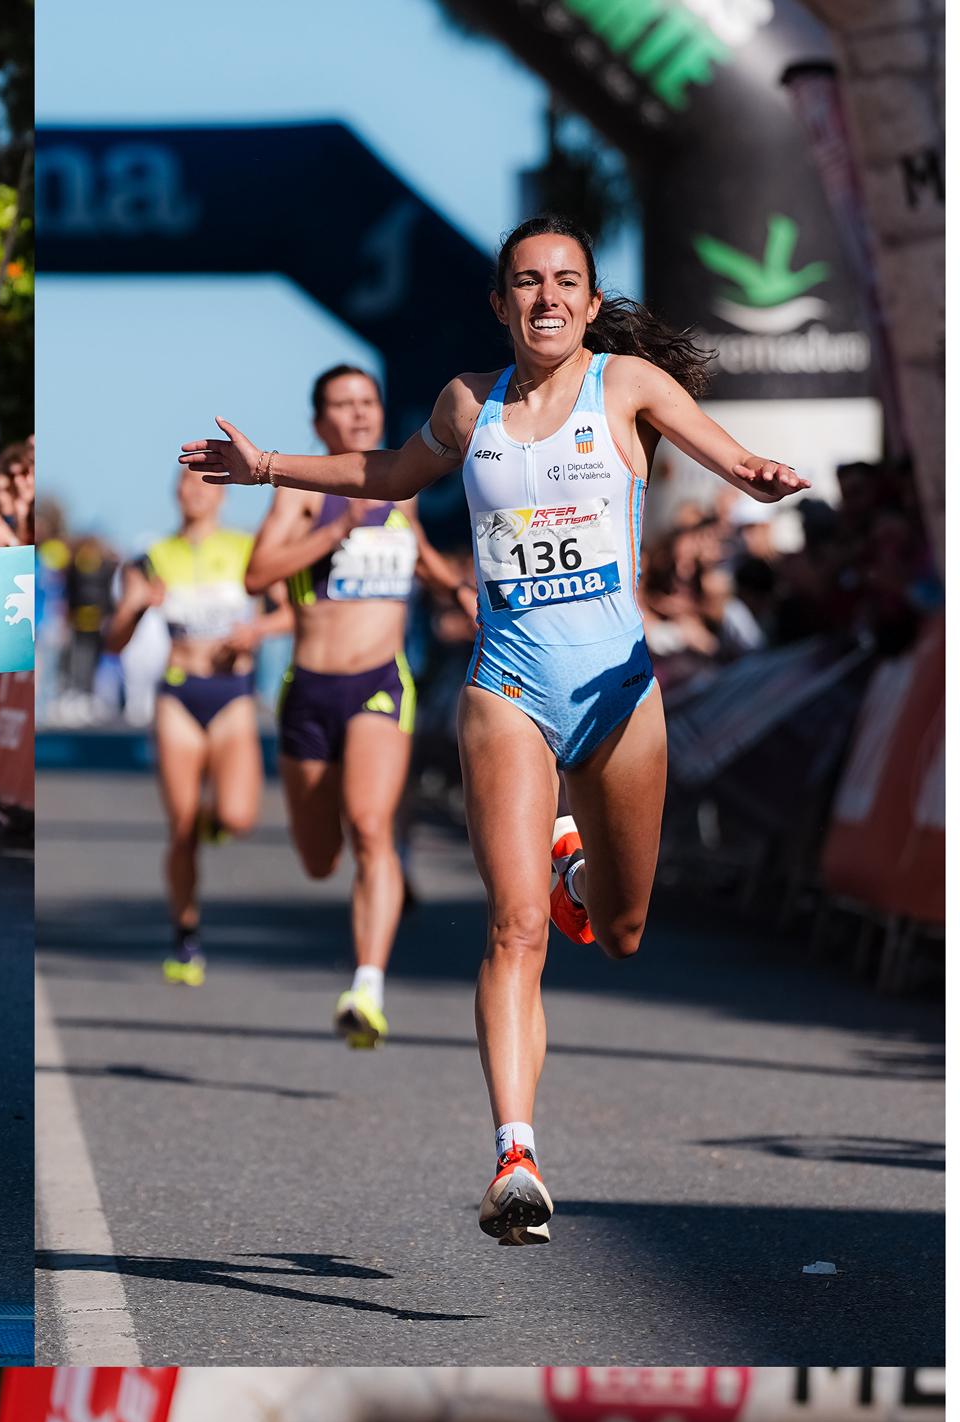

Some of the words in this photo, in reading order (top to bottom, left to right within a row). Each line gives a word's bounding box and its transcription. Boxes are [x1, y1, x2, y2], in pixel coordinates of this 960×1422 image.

[567, 462, 604, 472] Diputació
[568, 472, 578, 480] de
[580, 471, 611, 480] València
[534, 507, 577, 519] RFEA
[510, 538, 582, 575] 136
[518, 572, 605, 606] Joma
